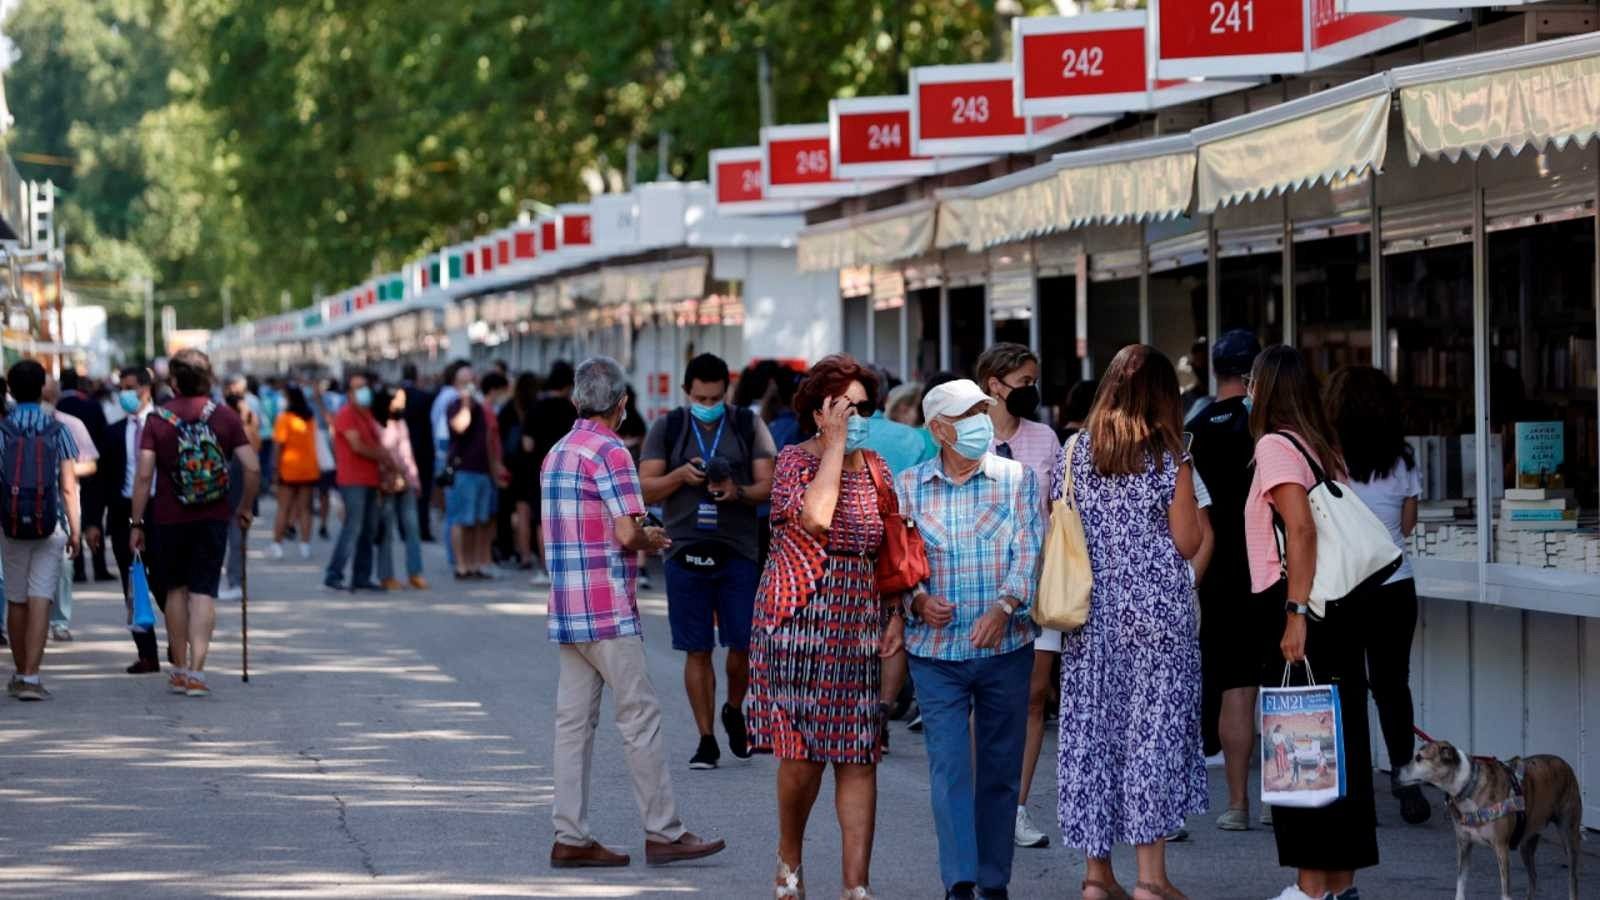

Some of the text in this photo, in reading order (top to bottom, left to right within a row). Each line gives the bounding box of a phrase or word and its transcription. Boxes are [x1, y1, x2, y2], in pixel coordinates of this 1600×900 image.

[1209, 0, 1255, 34] 241
[1061, 46, 1104, 78] 242
[952, 95, 989, 124] 243
[867, 123, 901, 150] 244
[796, 149, 827, 174] 245
[741, 169, 761, 192] 24
[685, 554, 715, 567] FILA
